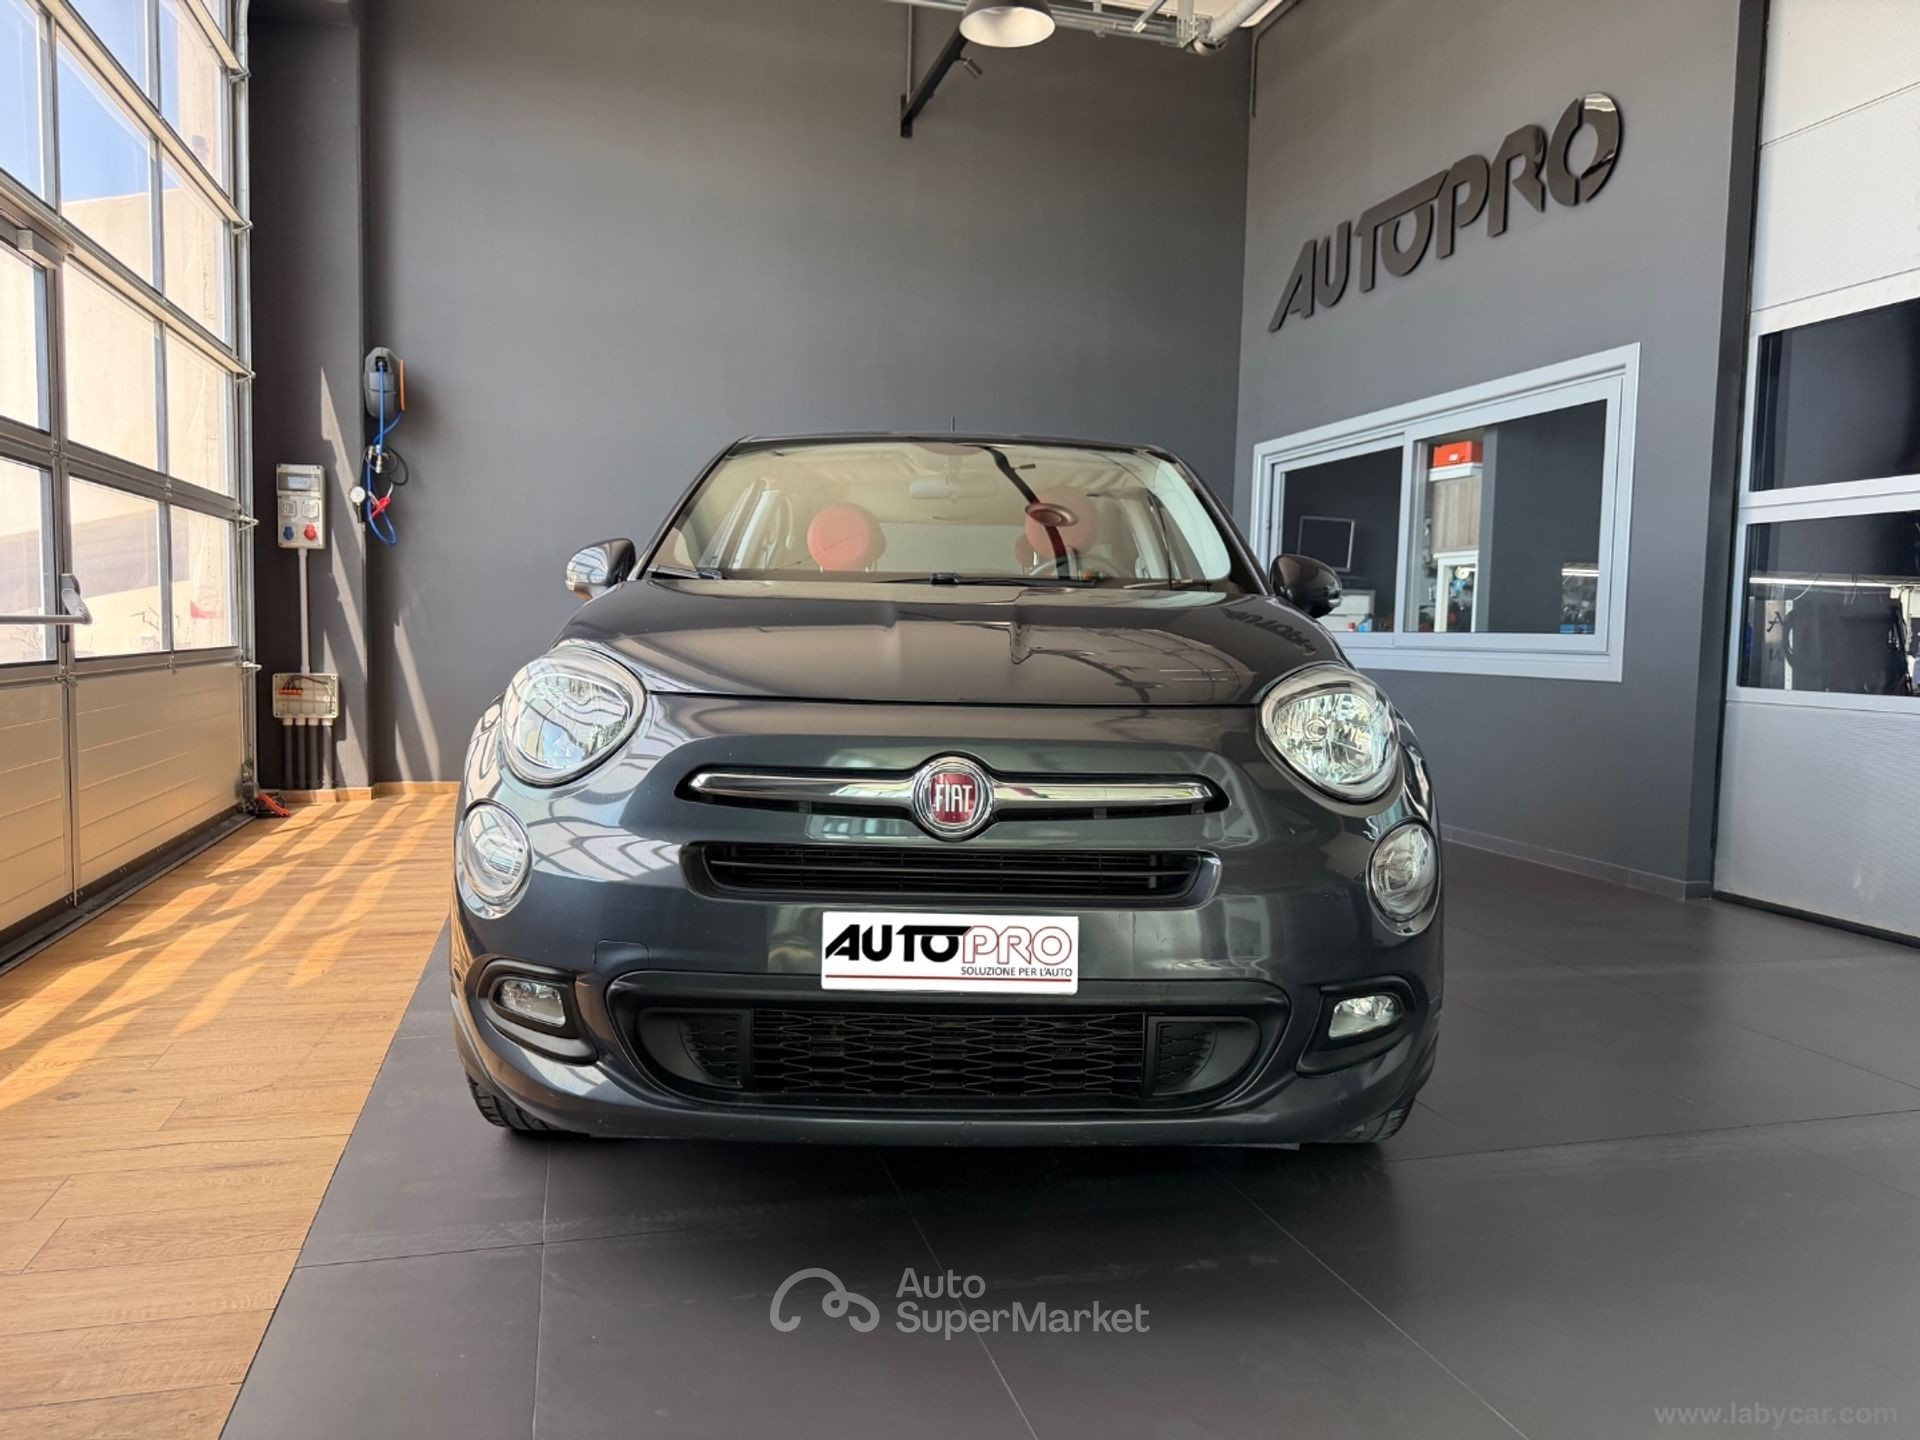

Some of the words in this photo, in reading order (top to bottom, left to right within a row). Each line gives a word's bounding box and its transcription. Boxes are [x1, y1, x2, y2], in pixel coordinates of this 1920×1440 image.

[1268, 92, 1624, 333] AUTOPRO
[935, 783, 973, 813] FIAT
[825, 924, 1073, 966] AUTOPRO
[960, 966, 1017, 976] SOLUZIONE
[1018, 967, 1038, 977] PER
